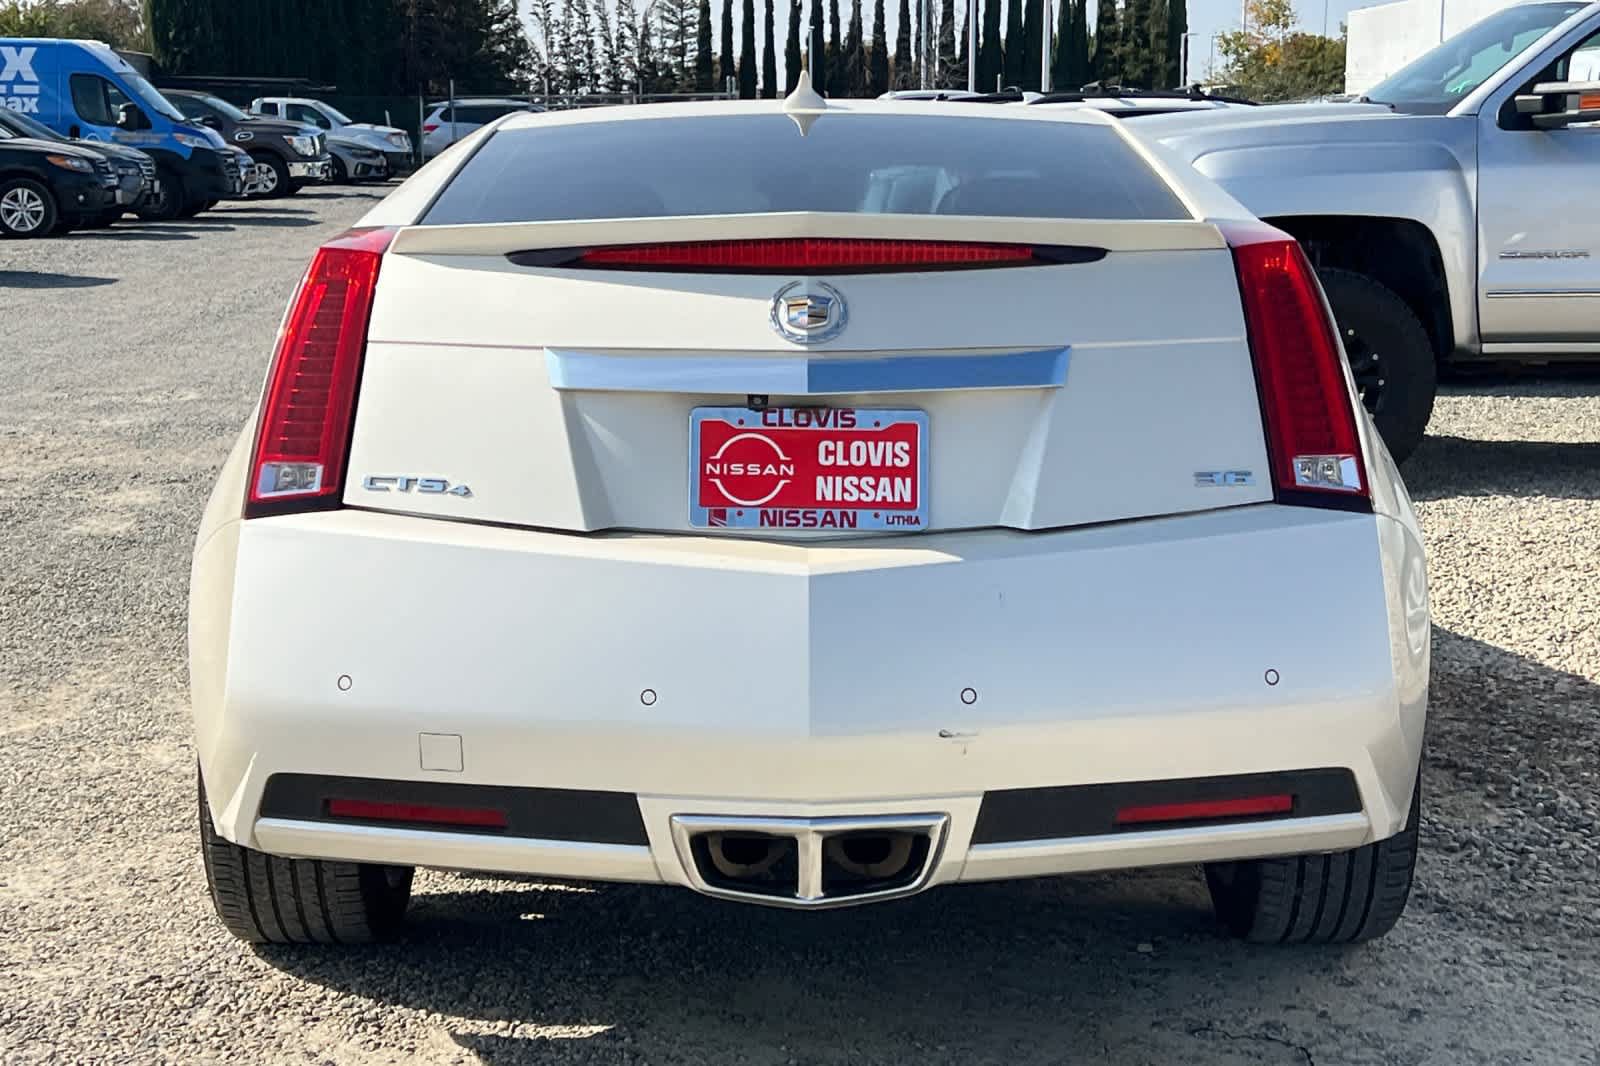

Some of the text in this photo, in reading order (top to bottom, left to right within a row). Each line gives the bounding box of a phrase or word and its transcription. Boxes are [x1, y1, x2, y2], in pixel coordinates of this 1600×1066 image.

[761, 408, 857, 429] CLOVIS
[817, 440, 910, 467] CLOVIS
[705, 463, 795, 476] NISSAN
[815, 475, 912, 503] NISSAN
[759, 509, 858, 529] NISSAN
[886, 515, 921, 526] LITHIA
